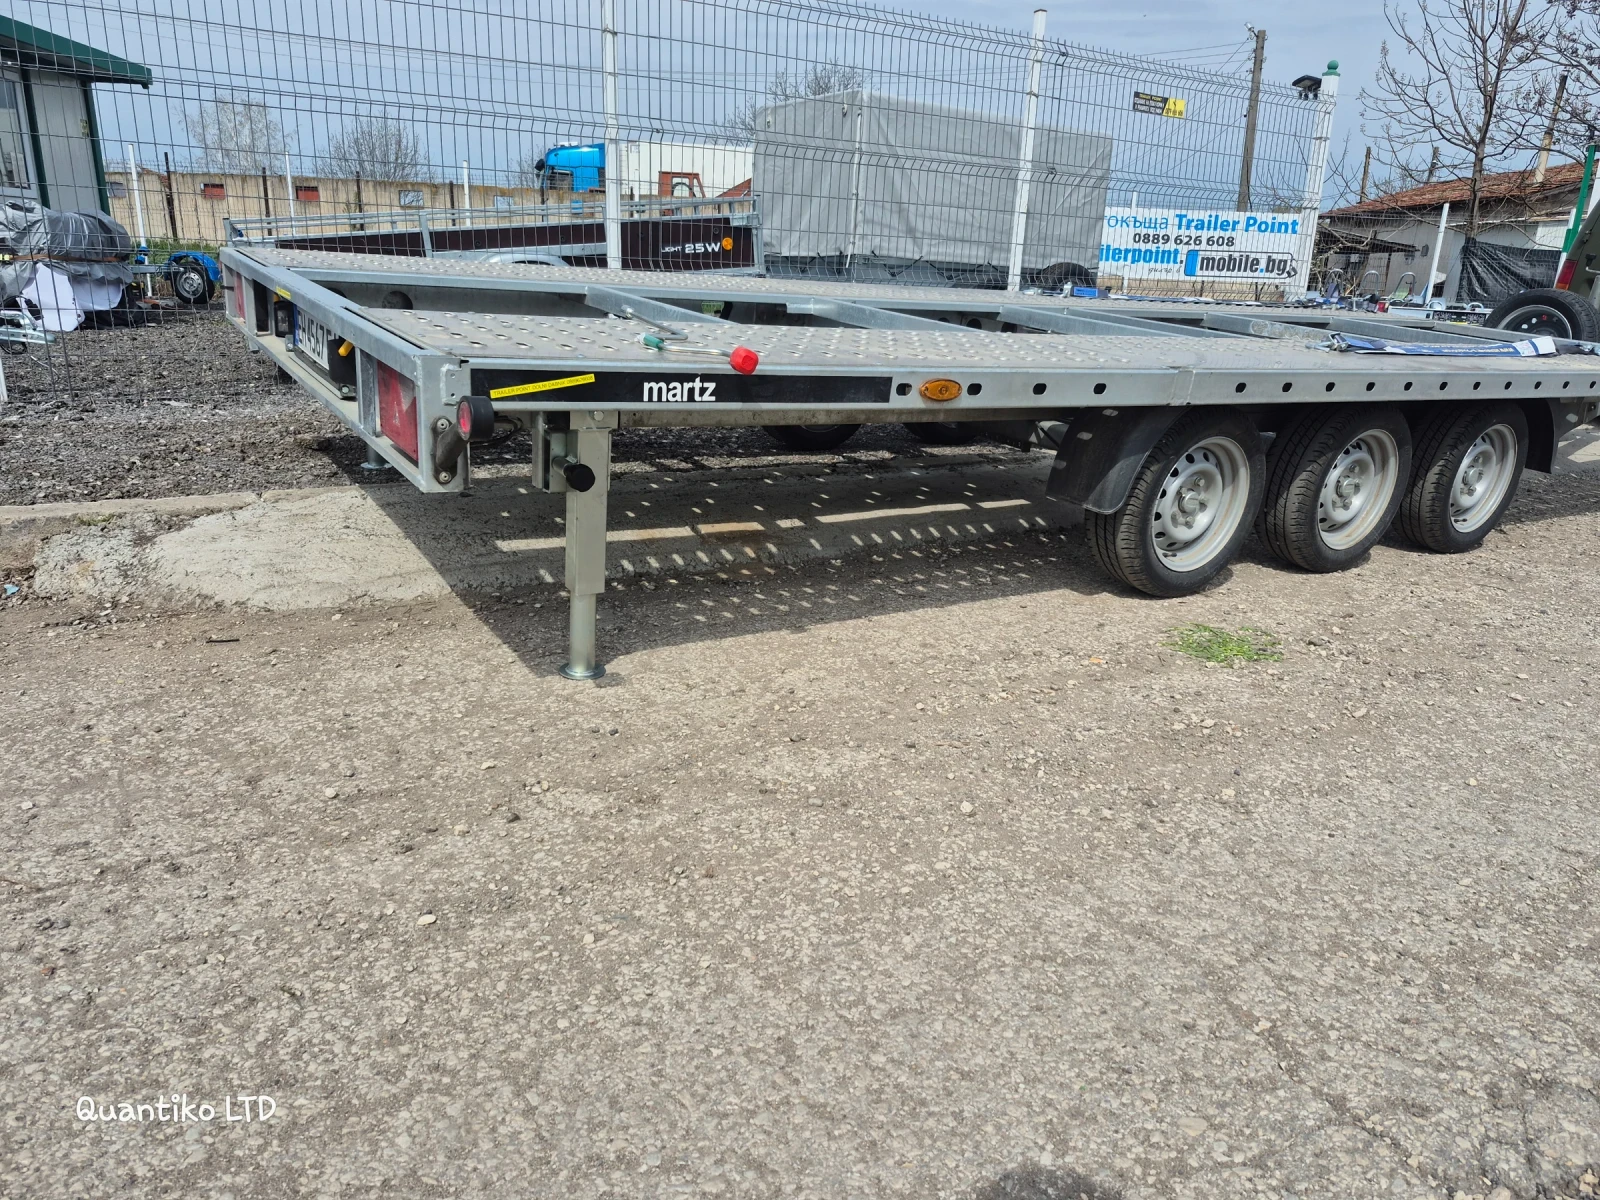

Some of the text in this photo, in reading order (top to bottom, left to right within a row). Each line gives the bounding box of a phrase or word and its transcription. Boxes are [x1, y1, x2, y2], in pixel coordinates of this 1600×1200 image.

[1175, 213, 1240, 233] Trailer
[1244, 216, 1299, 235] Point
[684, 242, 721, 254] 25W
[1133, 233, 1235, 247] 0889 626 608
[1199, 254, 1288, 276] mobile.bg
[515, 386, 531, 394] POINT
[642, 376, 716, 402] martz
